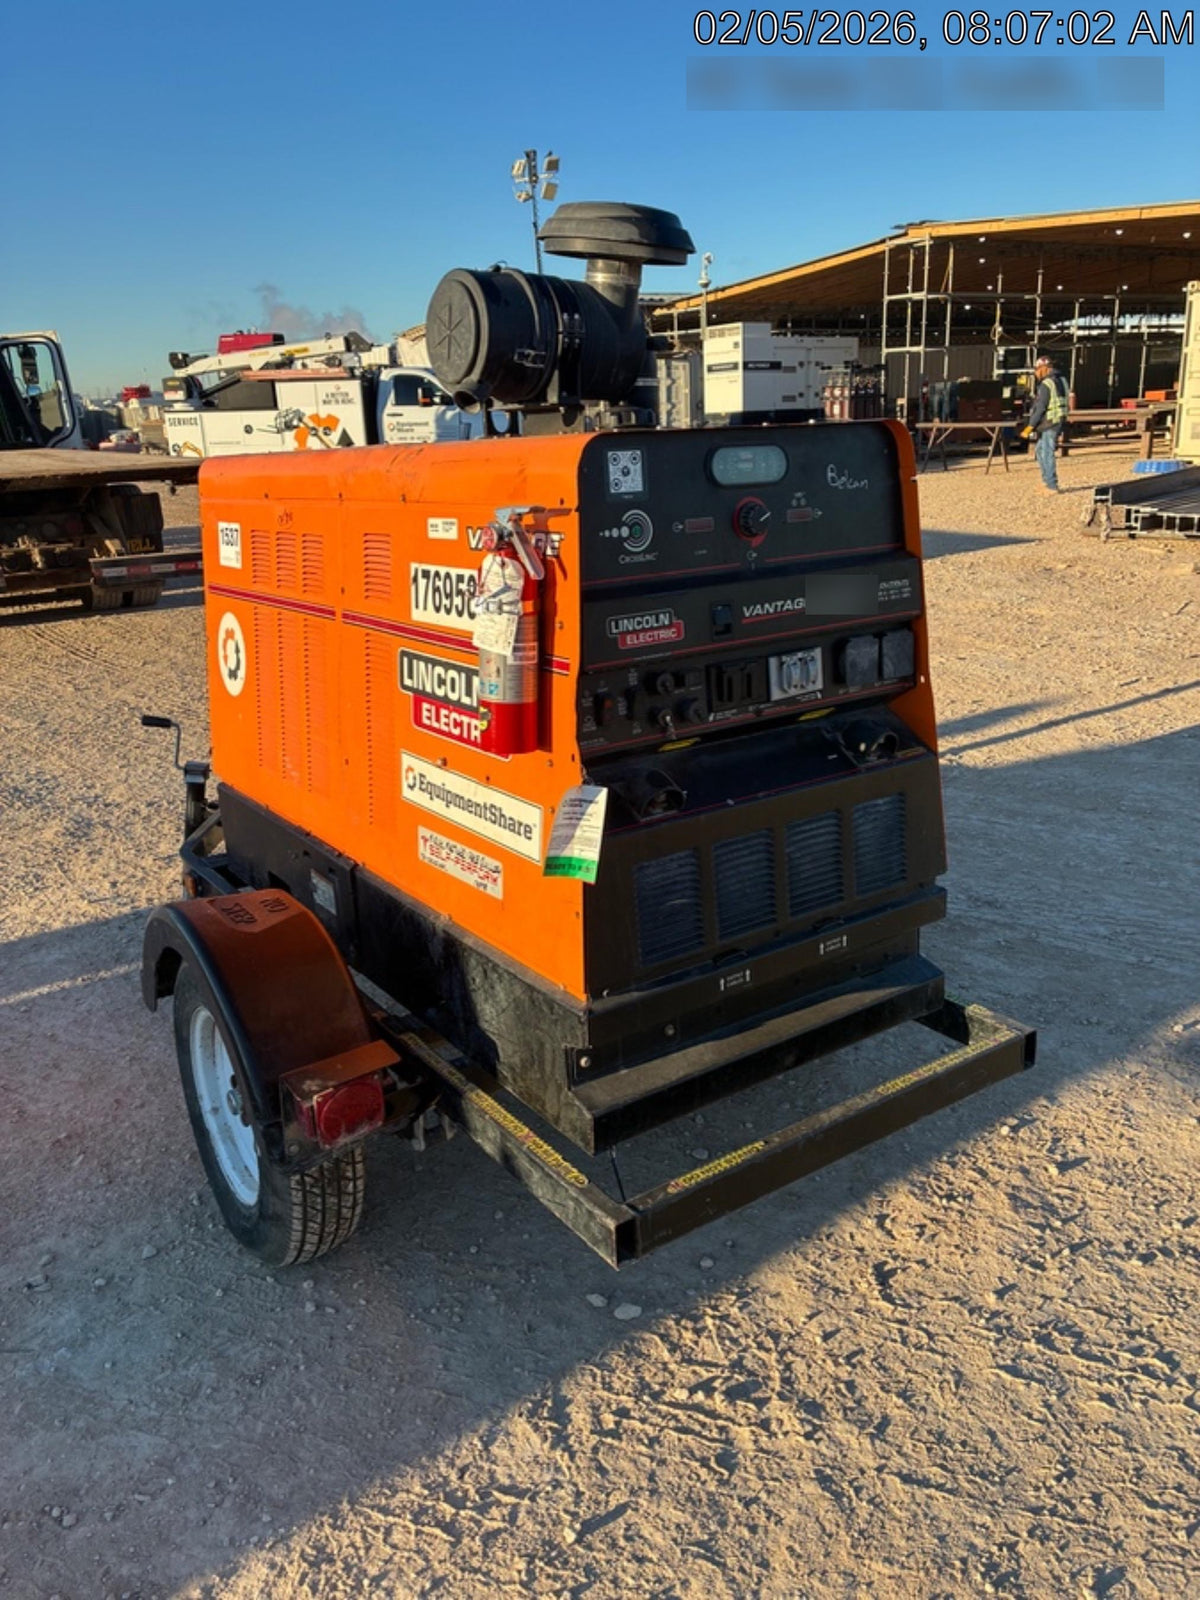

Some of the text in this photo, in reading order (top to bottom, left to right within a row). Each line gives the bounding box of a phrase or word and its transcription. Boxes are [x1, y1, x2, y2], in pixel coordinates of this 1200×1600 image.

[168, 416, 199, 427] SERVICE
[742, 598, 806, 618] VANTAG
[610, 611, 670, 634] LINCOLN
[625, 627, 679, 645] ELECTRIC
[422, 702, 481, 744] ELECTR
[418, 773, 533, 841] EquipmentShare
